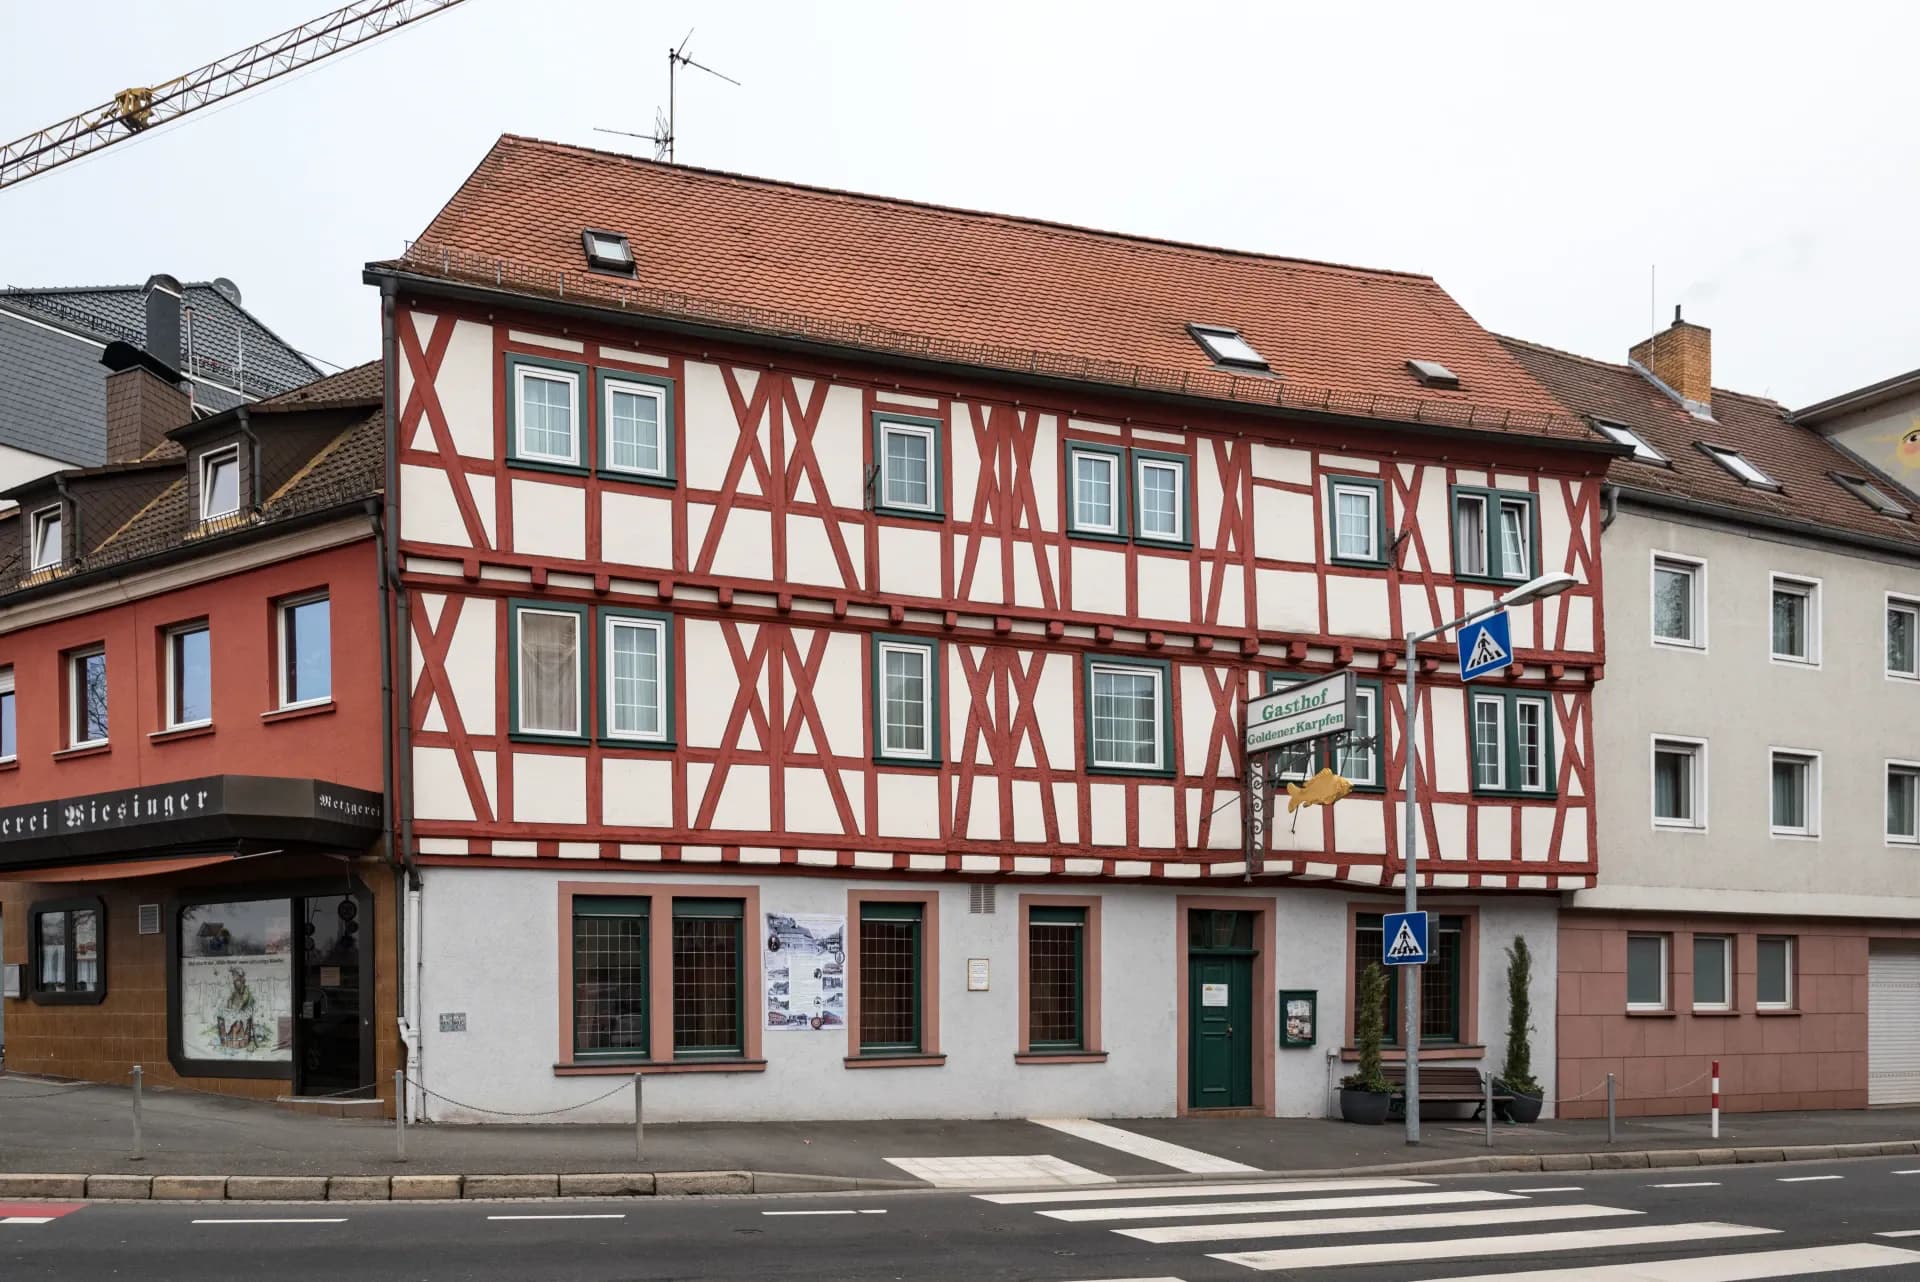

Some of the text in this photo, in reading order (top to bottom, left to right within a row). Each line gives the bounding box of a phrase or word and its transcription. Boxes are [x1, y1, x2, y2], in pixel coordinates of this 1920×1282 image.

[1262, 688, 1328, 721] Gasthof
[1247, 712, 1344, 745] Goldener Karpfen
[64, 790, 208, 828] Wiesinger
[319, 793, 380, 817] Metzgerei
